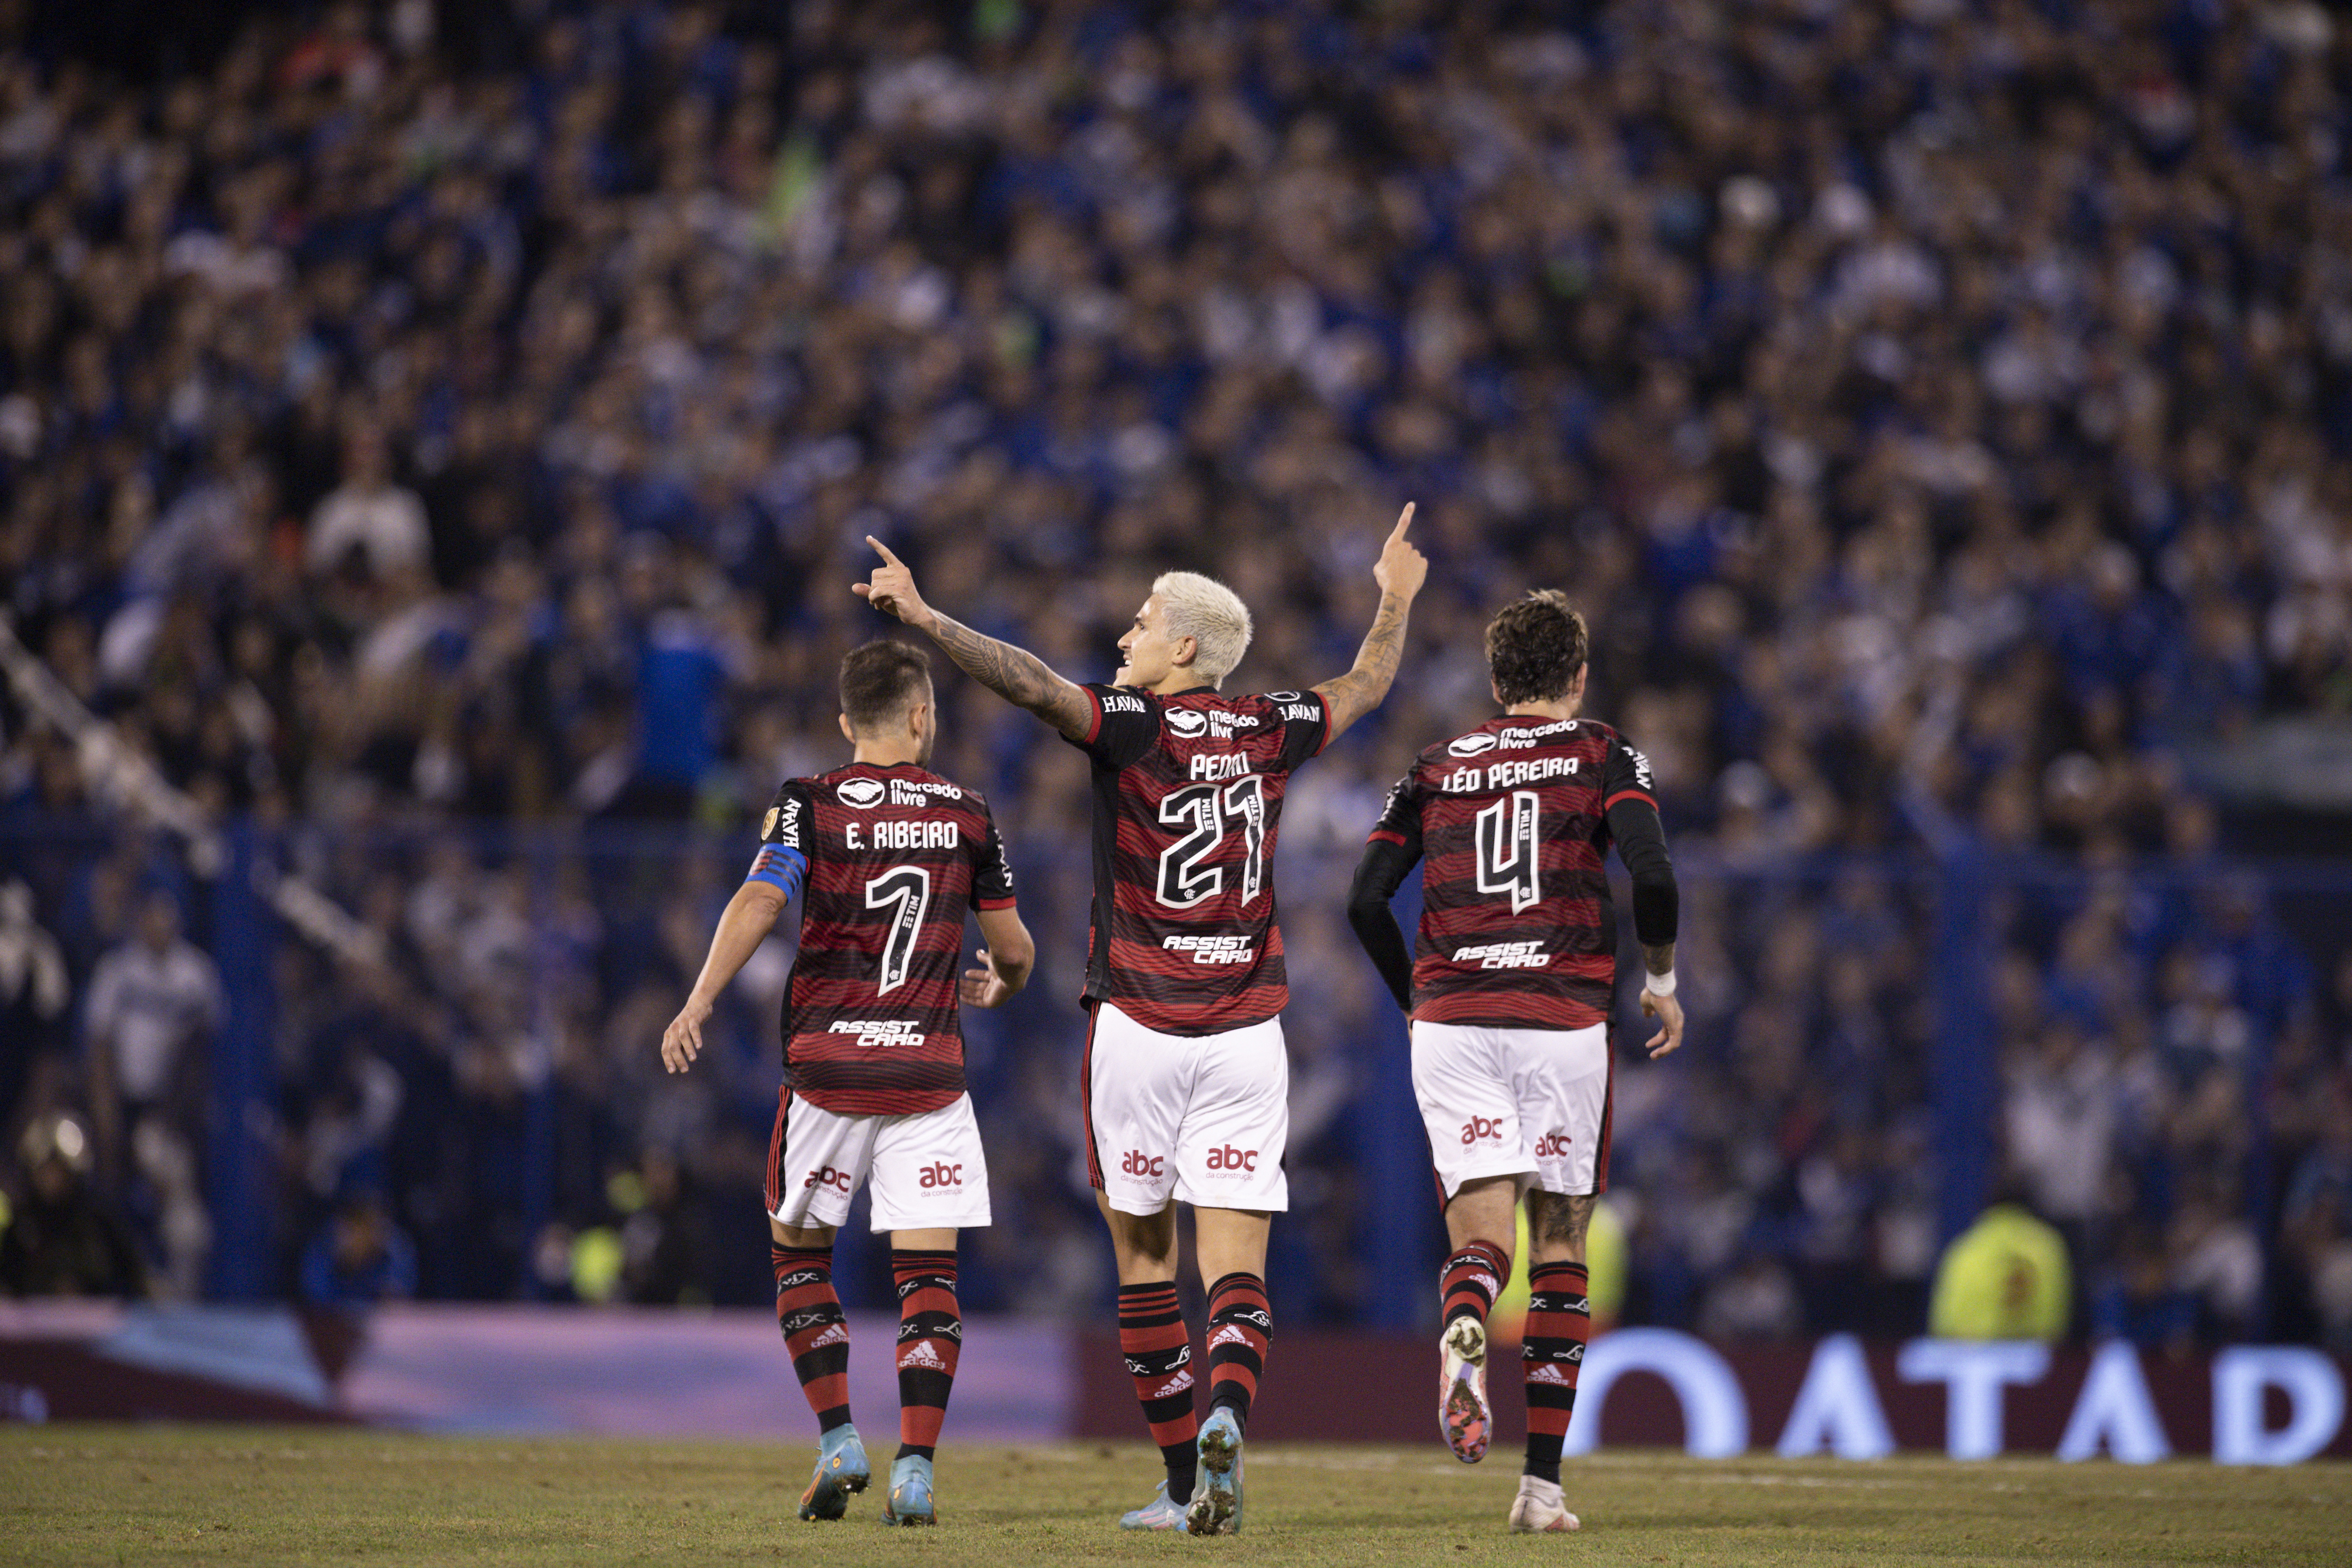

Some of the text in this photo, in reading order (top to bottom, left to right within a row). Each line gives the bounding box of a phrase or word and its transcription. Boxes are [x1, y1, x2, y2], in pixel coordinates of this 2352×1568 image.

[1210, 721, 1233, 741] livr
[1500, 720, 1578, 739] mercado
[1499, 736, 1537, 750] livre
[1441, 757, 1579, 793] LÉO PEREIRA
[890, 779, 962, 800] mercado
[891, 789, 927, 807] livre
[1202, 798, 1212, 820] TIM
[1247, 794, 1260, 815] TIM
[782, 798, 802, 849] HAVAN
[1520, 809, 1531, 830] TIM
[846, 820, 958, 850] E. RIBEIRO
[1156, 775, 1265, 909] 21
[1475, 791, 1540, 917] 4
[906, 895, 920, 915] TIM
[866, 865, 930, 998] 7
[1162, 936, 1252, 950] ASSIST
[1452, 940, 1544, 962] ASSIST
[1193, 949, 1252, 964] CARD
[1481, 953, 1551, 969] CARD
[828, 1020, 919, 1035] ASSIST
[856, 1033, 925, 1047] CARD
[1461, 1115, 1503, 1145] abc
[1122, 1149, 1164, 1177] abc
[1206, 1143, 1258, 1172] abc
[804, 1165, 851, 1193] abc
[919, 1160, 963, 1188] abc
[1216, 1173, 1254, 1182] construção
[898, 1356, 946, 1371] adidas
[1527, 1374, 1570, 1386] adidas
